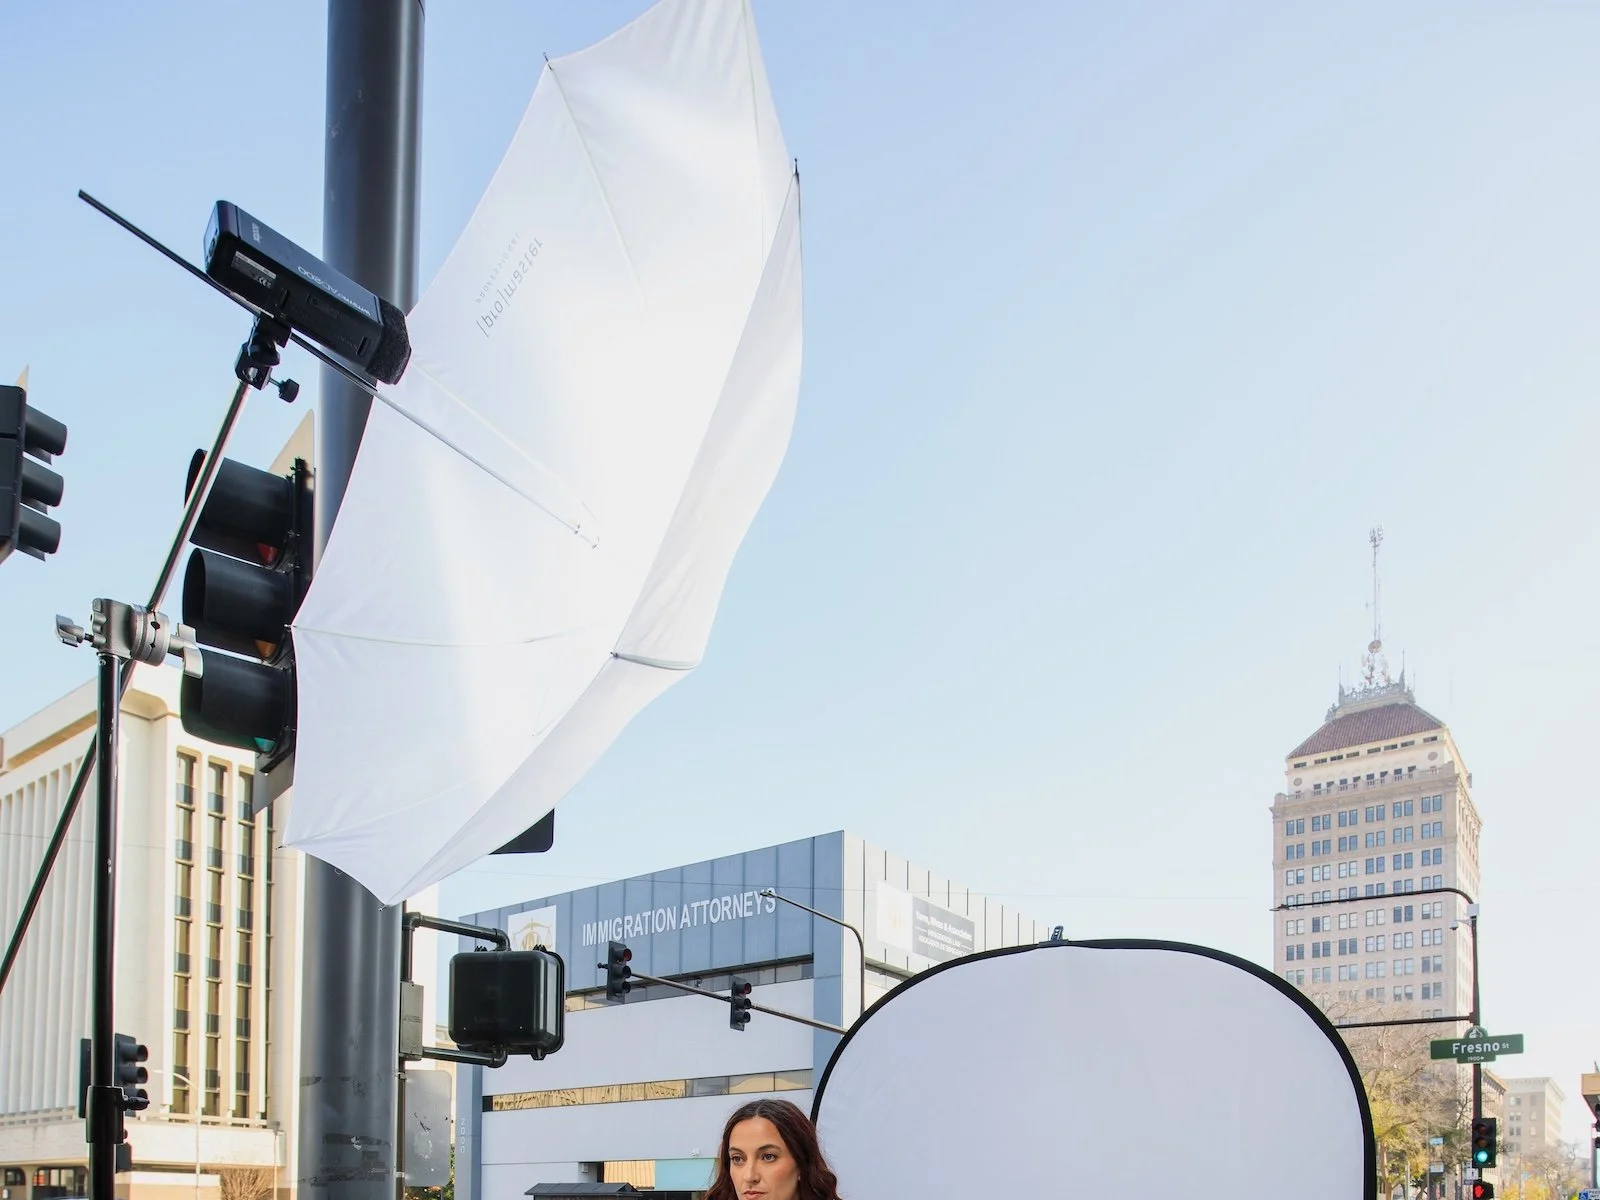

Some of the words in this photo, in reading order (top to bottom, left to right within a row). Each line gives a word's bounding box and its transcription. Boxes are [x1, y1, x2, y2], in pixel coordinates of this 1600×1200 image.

[582, 906, 676, 946] IMMIGRATION
[680, 887, 776, 929] ATTORNEYS
[1452, 1042, 1500, 1055] Fresno
